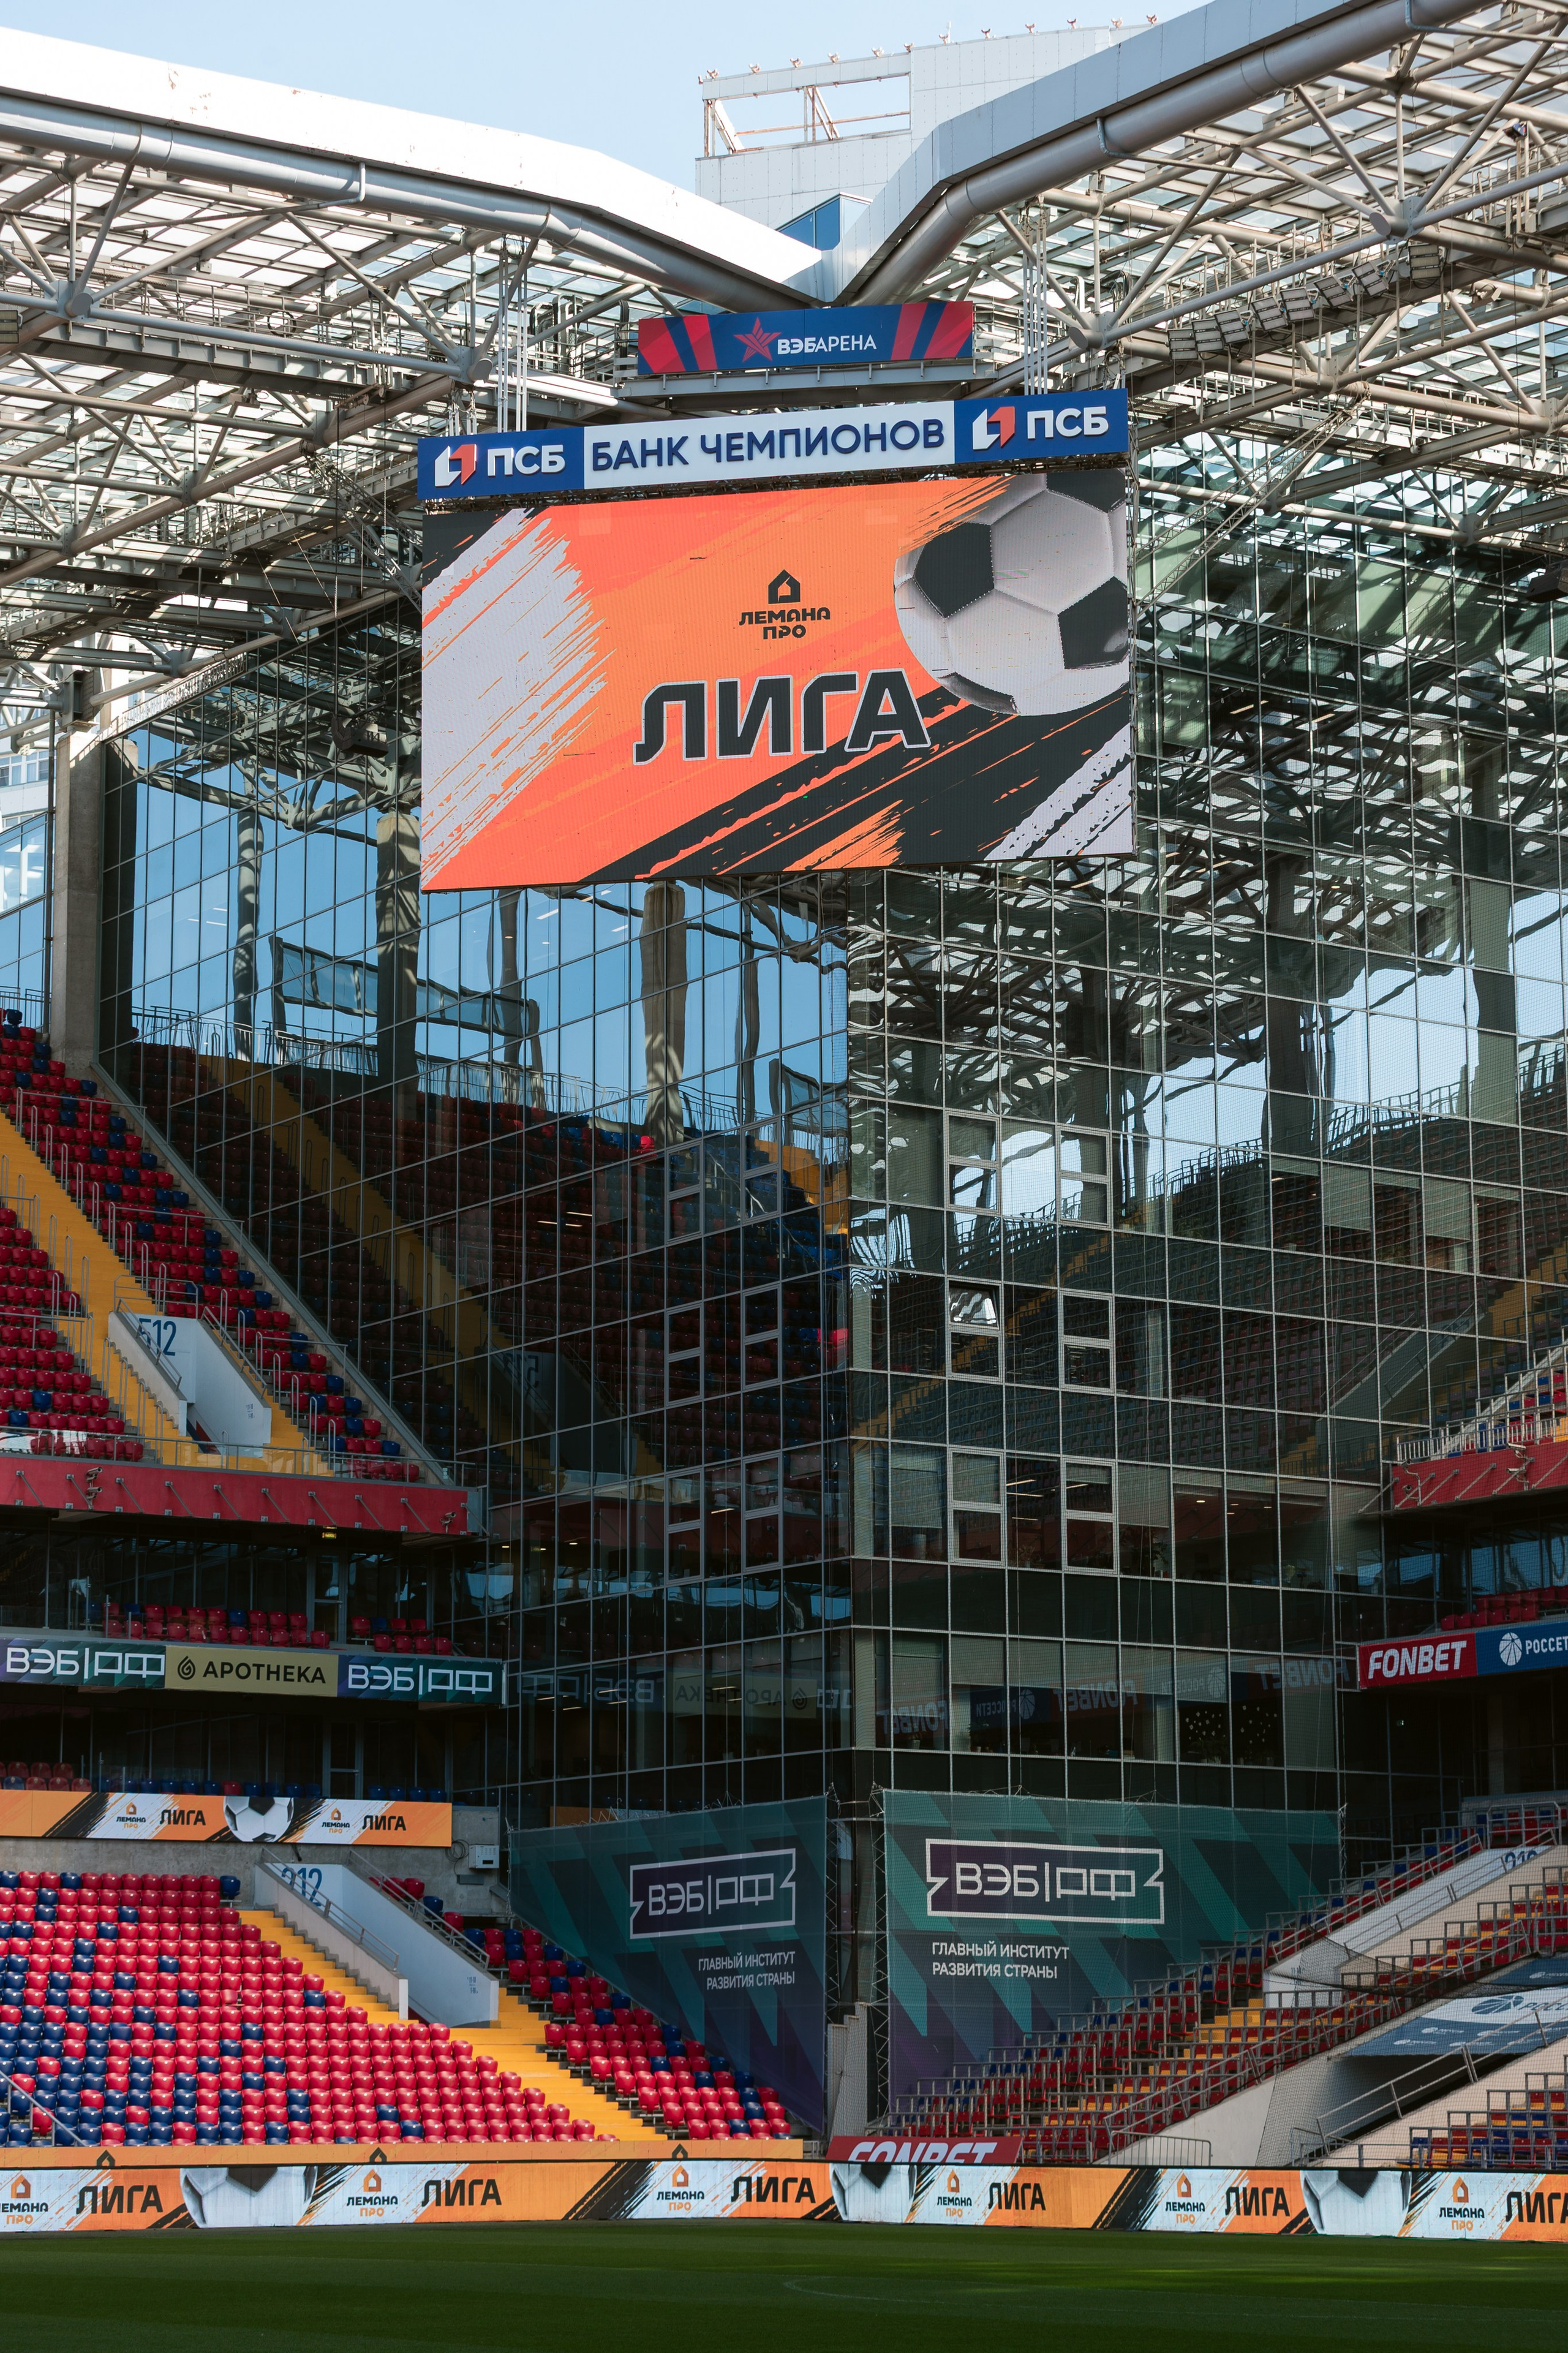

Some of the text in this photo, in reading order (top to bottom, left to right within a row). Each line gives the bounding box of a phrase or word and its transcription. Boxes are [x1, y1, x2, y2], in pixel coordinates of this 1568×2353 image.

[1027, 406, 1109, 440] ПСБ
[592, 419, 944, 471] БАНК ЧЕМПИОНОВ
[488, 444, 565, 477] ПСБ
[739, 607, 831, 625] ЛЕМАНА
[763, 624, 806, 640] ПРО
[633, 668, 931, 765] ЛИГА
[139, 1318, 176, 1356] 512
[1368, 1641, 1467, 1679] FONBET
[203, 1661, 326, 1683] APOTHEKA
[160, 1810, 206, 1826] ЛИГА
[362, 1815, 407, 1830] ЛИГА
[932, 1941, 1069, 1959] ГЛАВНЫЙ ИНСТИТУТ
[698, 1951, 795, 1971] ГЛАВНЫЙ ИНСТИТУТ
[933, 1962, 1057, 1979] РАЗВИТИЯ СТРАНЫ
[707, 1971, 795, 1990] РАЗВИТИЯ СТРАНЫ
[421, 2179, 502, 2207] ЛИГА
[657, 2191, 704, 2200] ЛЕМАНА
[731, 2177, 816, 2204] ЛИГА
[988, 2183, 1046, 2210] ЛИГА
[0, 2202, 48, 2213] ЕМАНА
[76, 2185, 164, 2215] ЛИГА
[347, 2196, 398, 2206] ЛЕМАНА
[669, 2202, 692, 2211] ПРО
[937, 2196, 972, 2207] ЛЕМАНА
[1165, 2202, 1205, 2212] ЛЕМАНА
[1225, 2186, 1290, 2216] ЛИГА
[6, 2215, 33, 2224] ПРО
[360, 2207, 385, 2217] ПРО
[946, 2208, 963, 2218] ПРО
[1176, 2213, 1196, 2224] ПРО
[1439, 2207, 1485, 2218] ЛЕМАНА
[1452, 2220, 1474, 2231] ПРО
